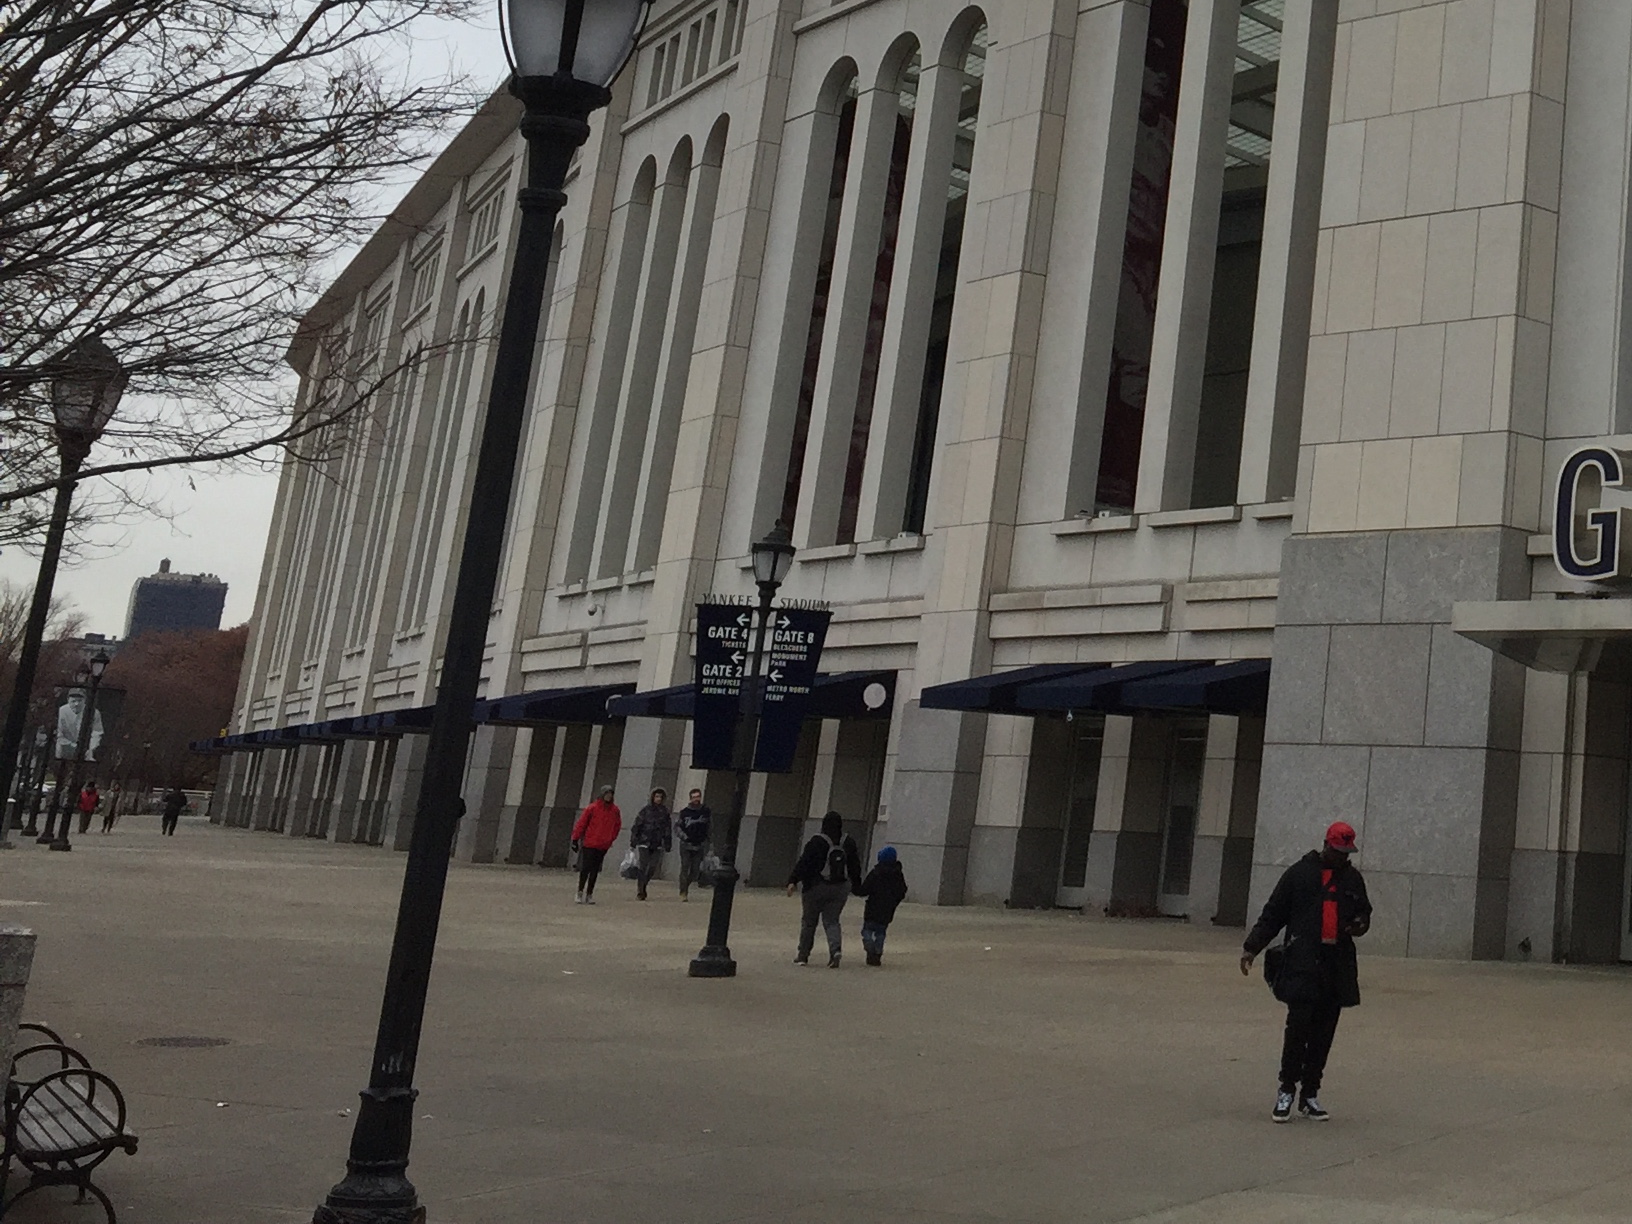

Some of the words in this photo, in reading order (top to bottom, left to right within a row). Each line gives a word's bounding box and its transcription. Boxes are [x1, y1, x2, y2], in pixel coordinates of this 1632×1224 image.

[702, 593, 752, 606] YANKEE
[780, 597, 831, 611] STADIUM
[708, 626, 737, 640] GATE
[741, 628, 748, 639] 4
[774, 630, 805, 644] GATE
[807, 632, 814, 644] 8
[702, 664, 733, 677] GATE
[735, 666, 743, 677] 2
